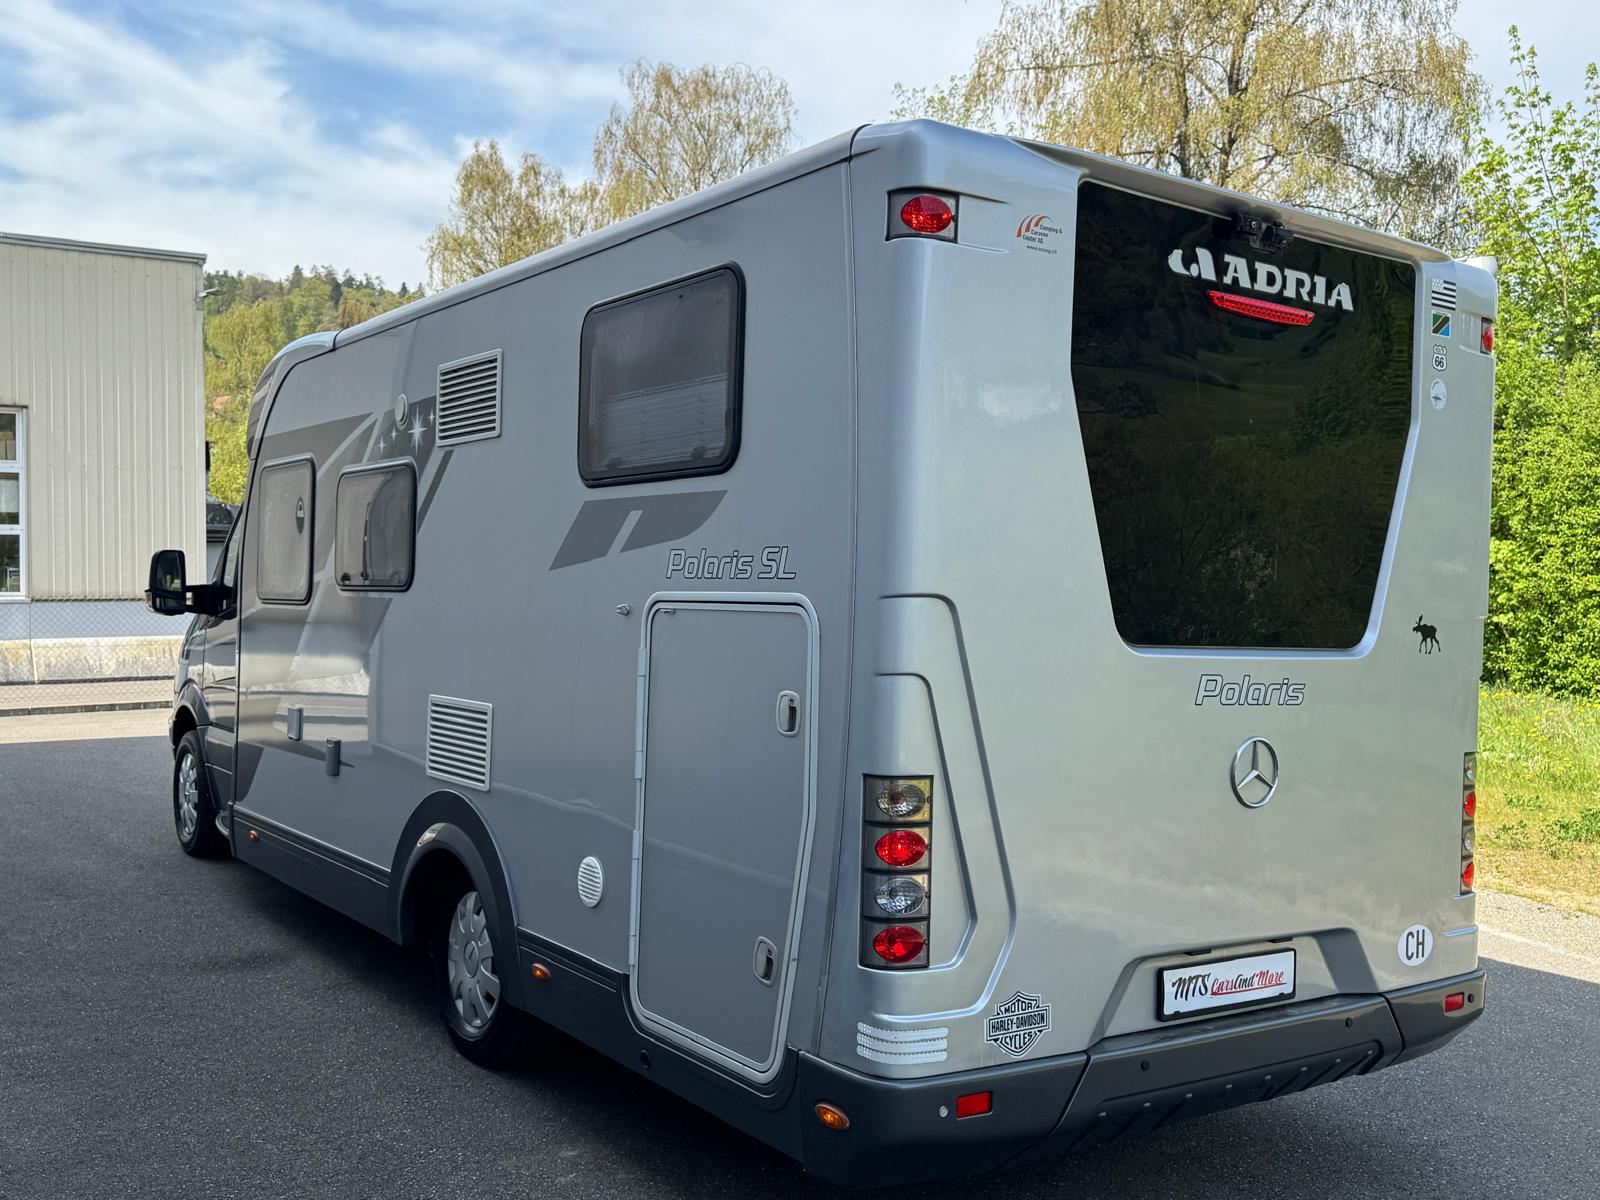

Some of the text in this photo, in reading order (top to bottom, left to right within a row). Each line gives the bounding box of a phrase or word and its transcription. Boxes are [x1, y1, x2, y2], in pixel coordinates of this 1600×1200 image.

[1223, 254, 1355, 312] ADRIA
[1434, 355, 1445, 369] 66
[666, 546, 797, 580] Polaris SL
[1194, 674, 1306, 706] Polaris
[1405, 929, 1425, 961] CH
[1171, 972, 1211, 1001] MTS
[1004, 999, 1033, 1015] MOTOR
[991, 1012, 1045, 1034] HARLEY-DAVIDSON
[1004, 1031, 1033, 1050] CYCLES
